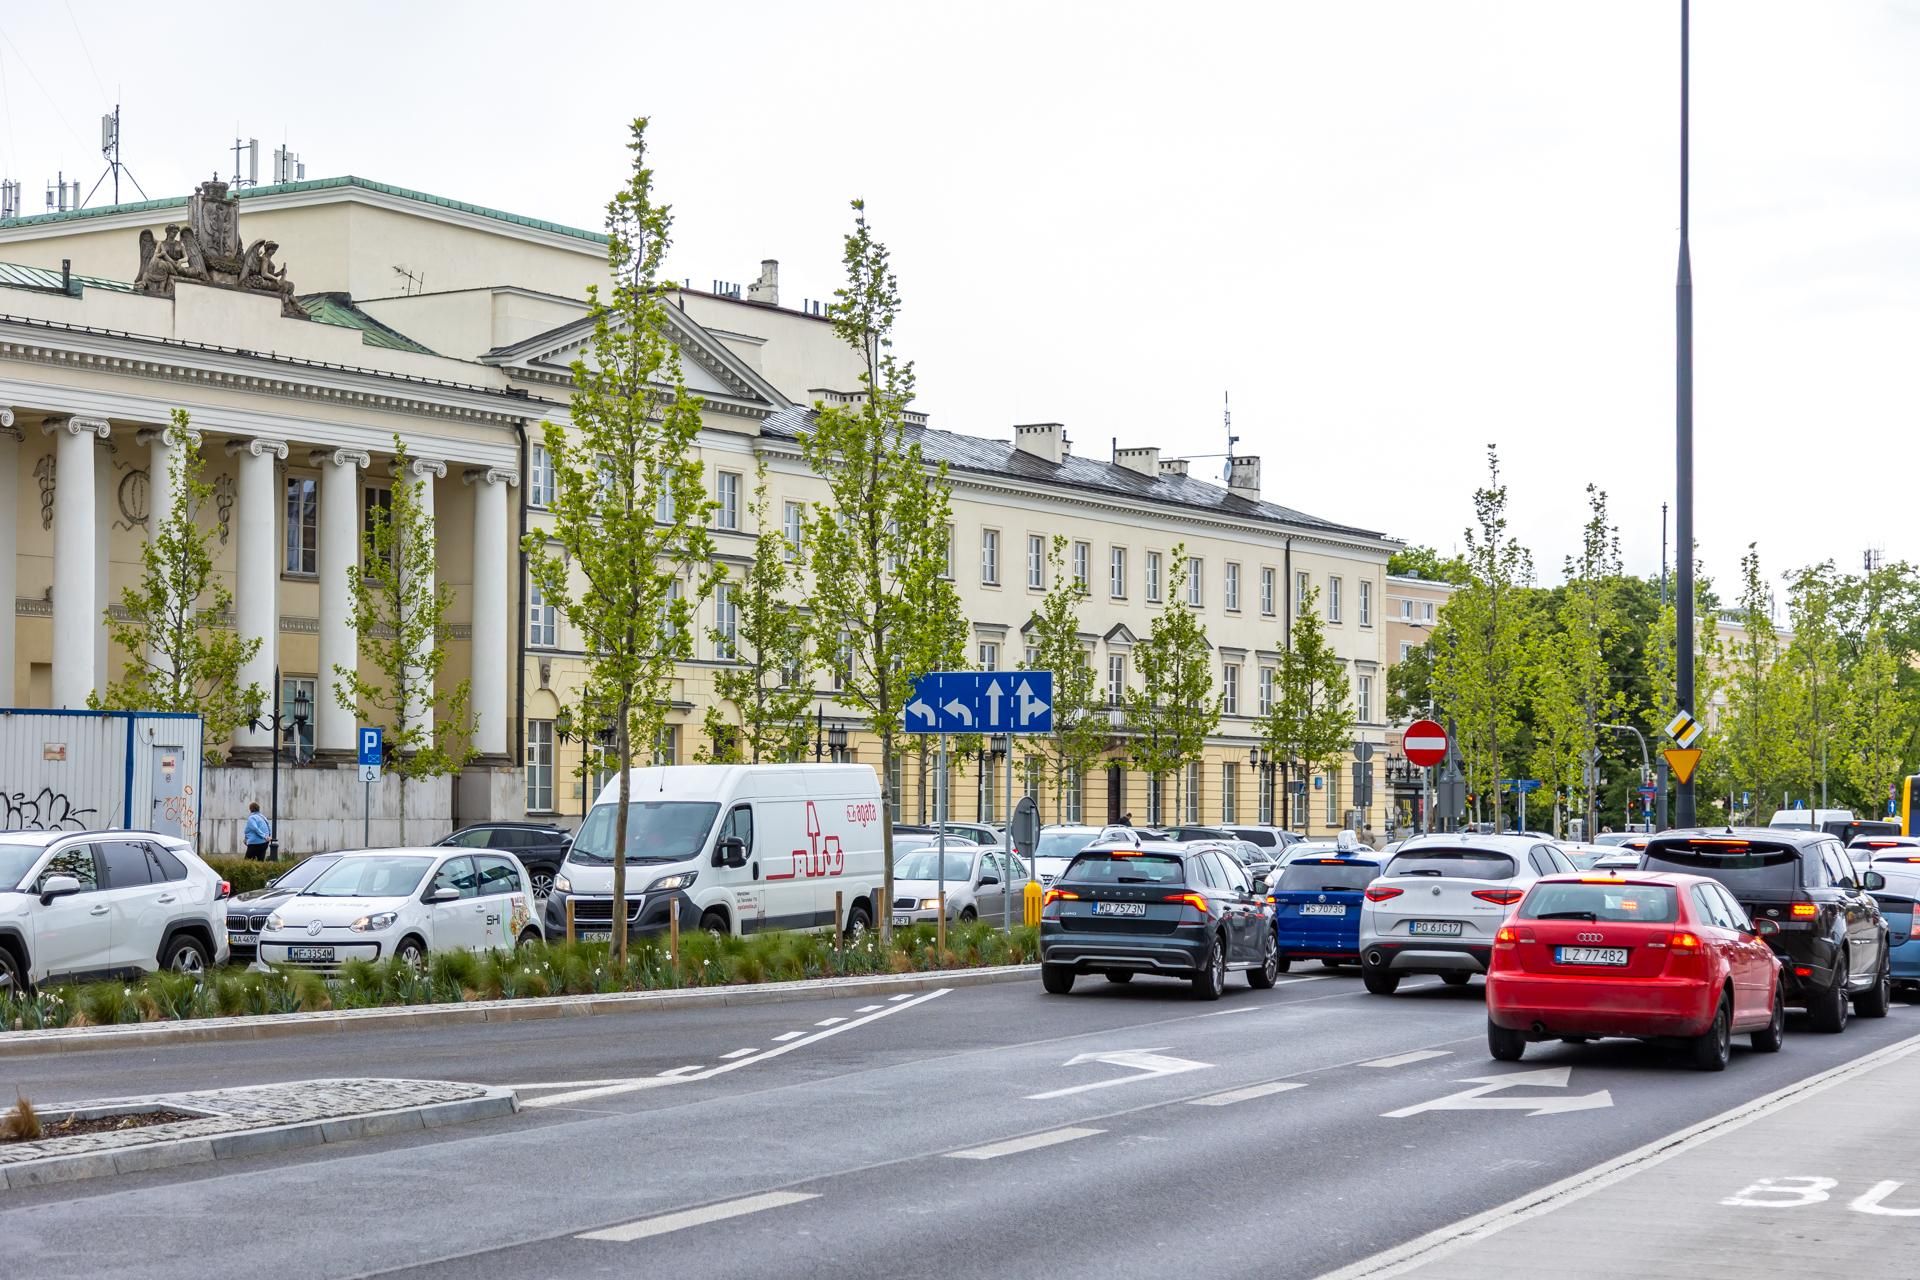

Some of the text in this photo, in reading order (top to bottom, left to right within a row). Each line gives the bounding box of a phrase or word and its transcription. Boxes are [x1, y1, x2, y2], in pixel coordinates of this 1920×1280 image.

[364, 731, 377, 754] P
[856, 801, 877, 828] agata
[1099, 903, 1144, 914] WD 7573N
[1430, 923, 1458, 933] 6JC17
[233, 935, 257, 944] AA 4692
[307, 949, 332, 958] 3354M
[1564, 948, 1624, 962] LZ 77482
